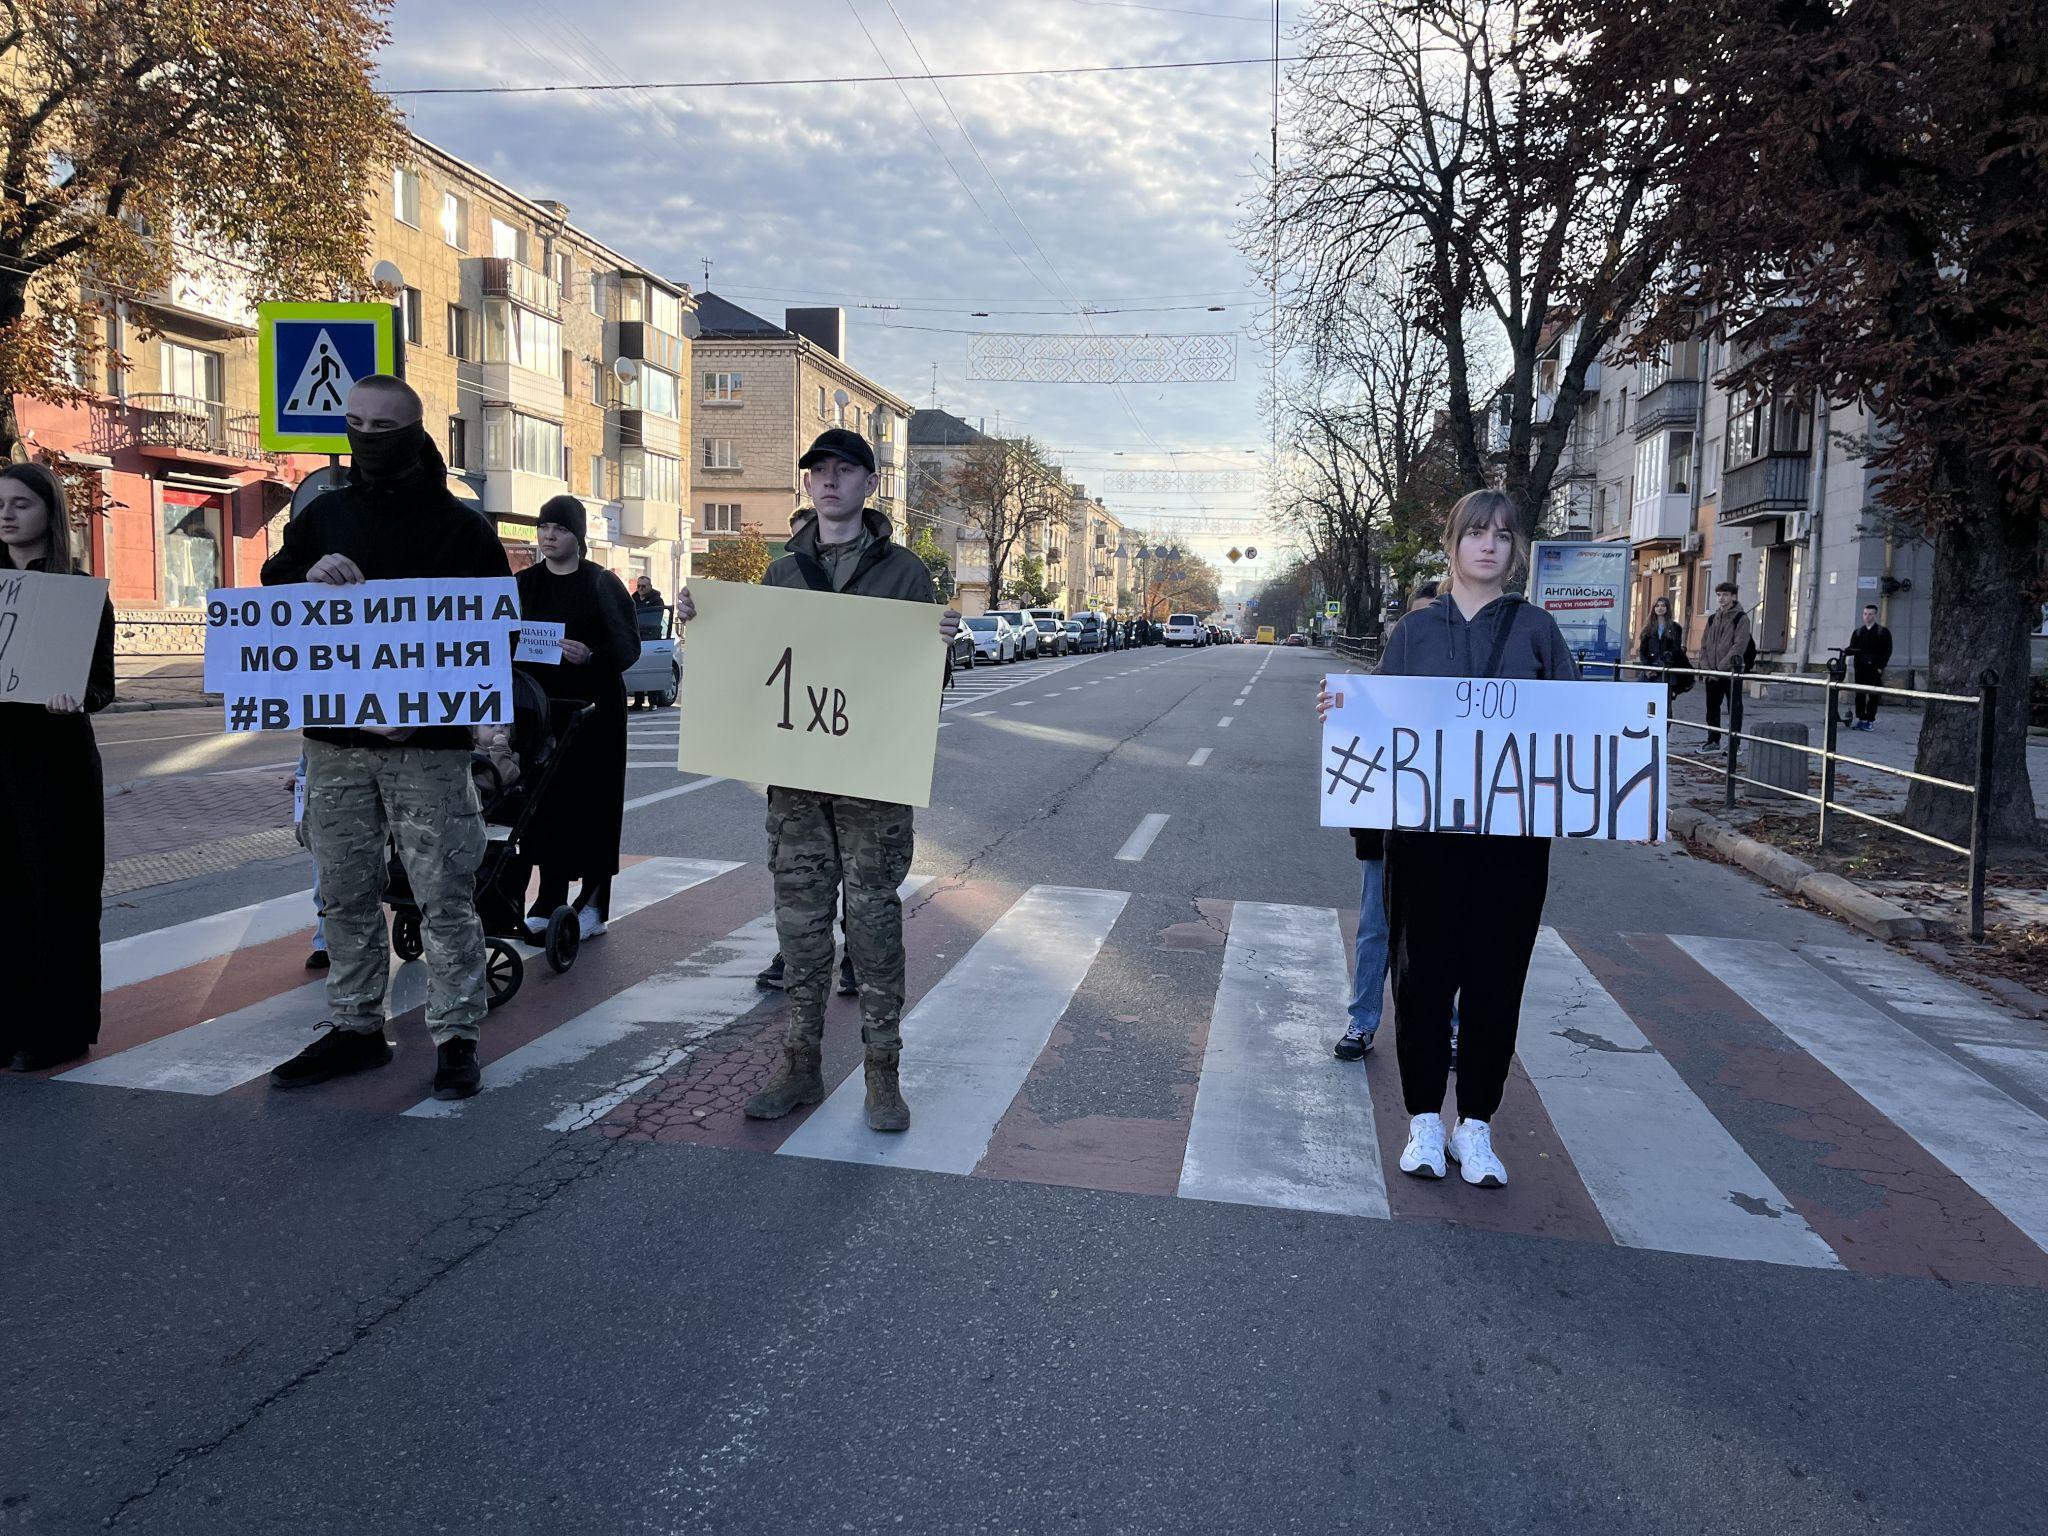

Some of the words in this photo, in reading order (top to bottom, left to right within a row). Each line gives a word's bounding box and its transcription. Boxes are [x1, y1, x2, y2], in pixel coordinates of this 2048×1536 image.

[1545, 586, 1616, 598] АНГЛІЙСЬКА,
[765, 645, 794, 732] 1
[1455, 680, 1517, 719] 9:00
[1325, 725, 1660, 842] #ВШАНУЙ
